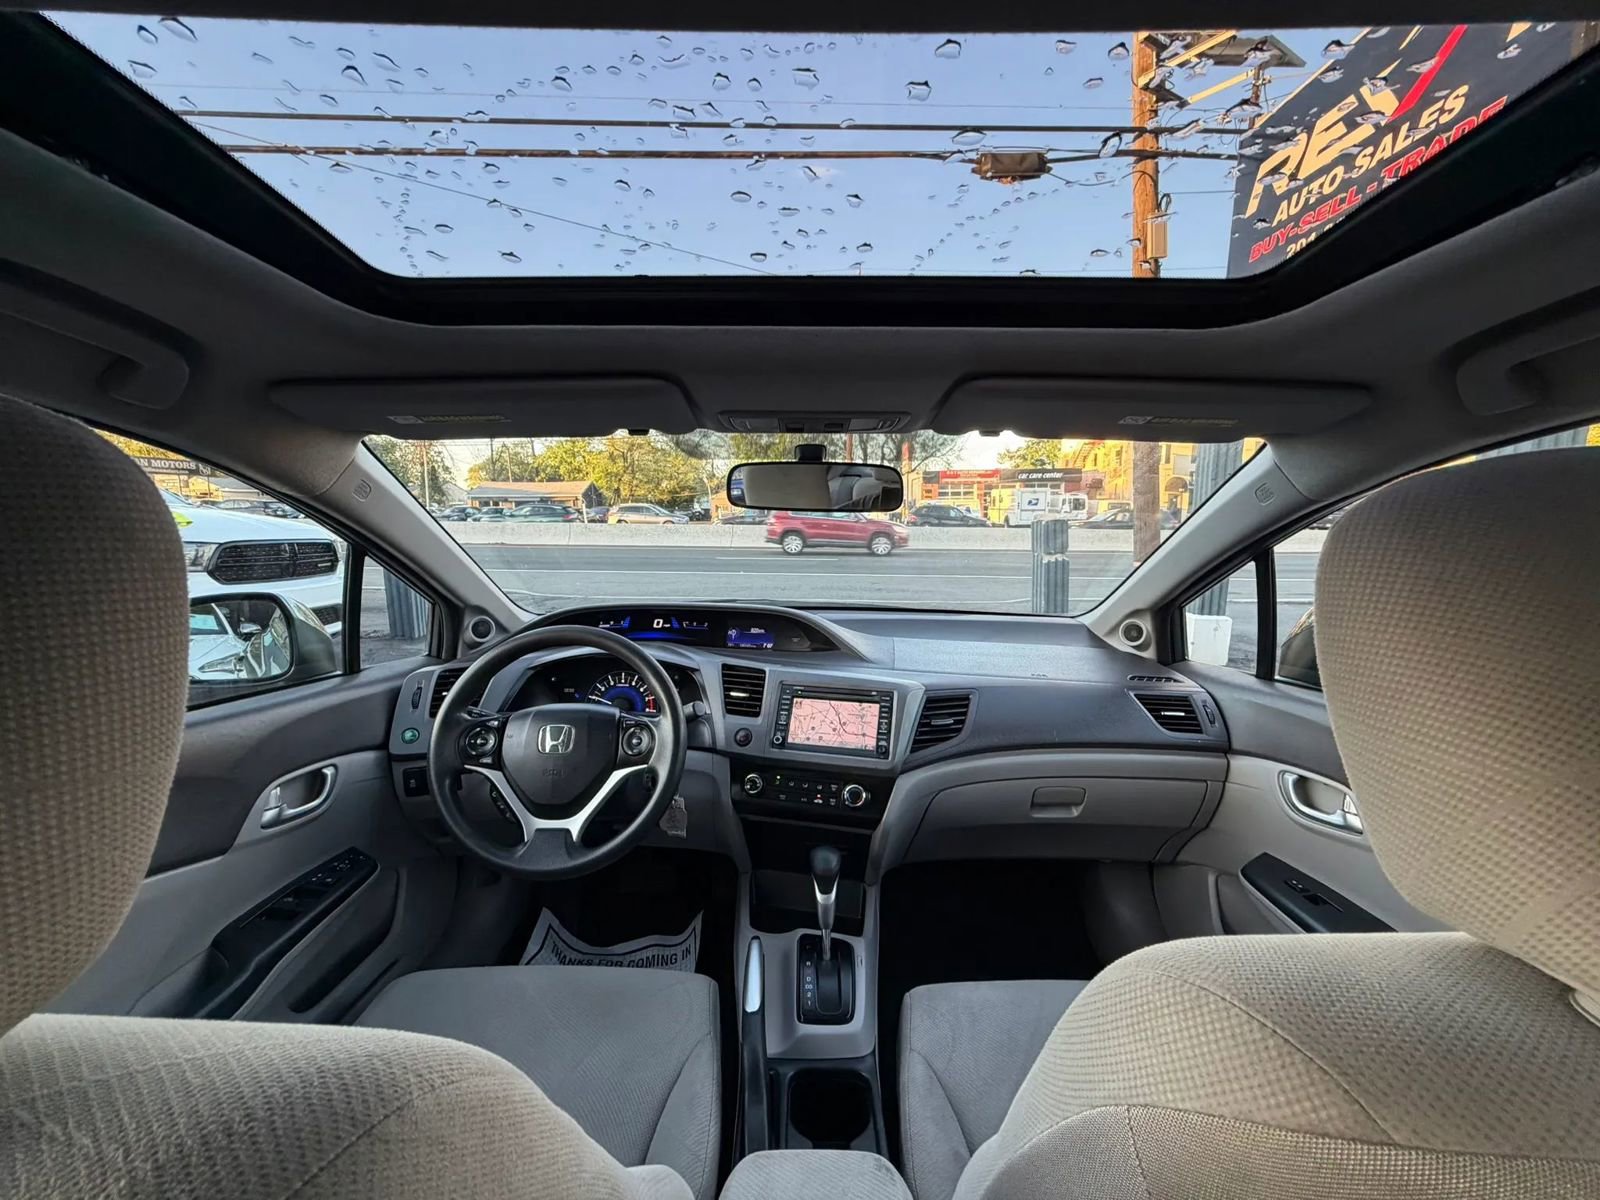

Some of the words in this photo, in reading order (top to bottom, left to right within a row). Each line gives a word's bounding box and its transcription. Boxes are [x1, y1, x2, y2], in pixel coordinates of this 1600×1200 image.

[1249, 186, 1363, 263] BUY-SELL
[1380, 95, 1509, 181] TRADE
[1272, 165, 1344, 227] AUTO
[1351, 84, 1469, 178] SALES
[150, 459, 196, 470] MOTORS
[551, 941, 594, 966] THANKS
[597, 958, 624, 967] FOR
[627, 953, 678, 968] COMING
[682, 944, 692, 961] IN
